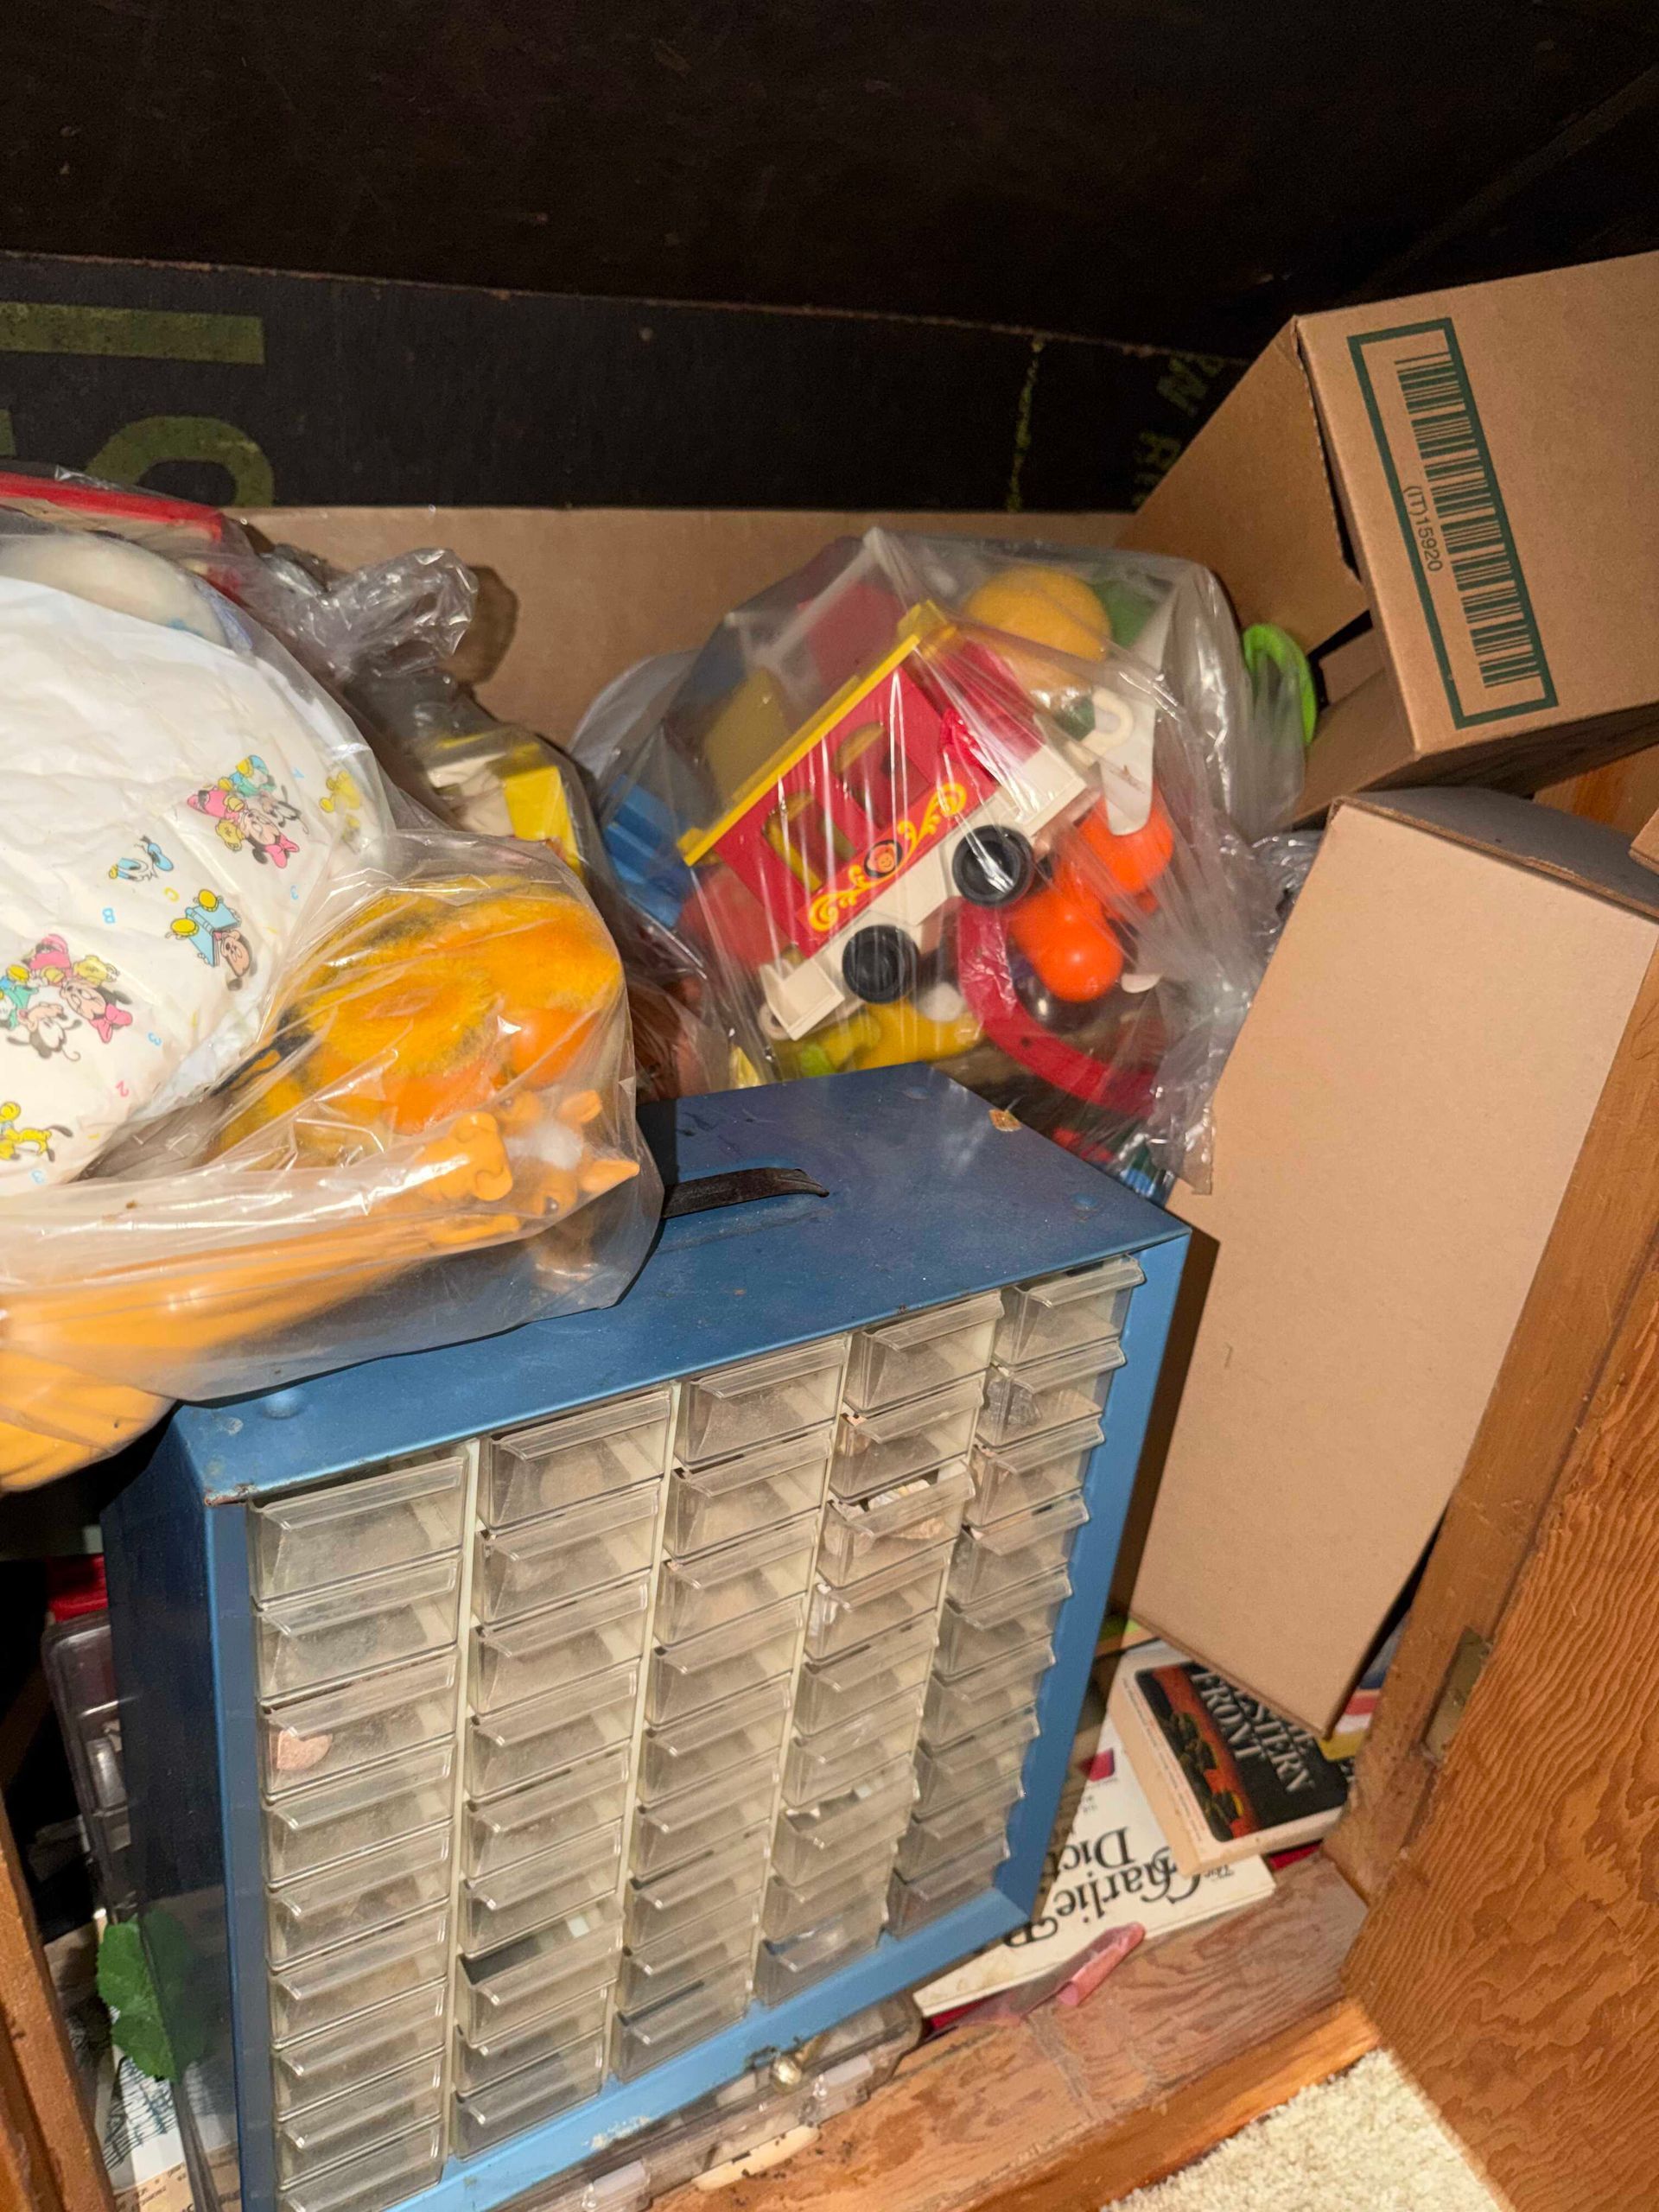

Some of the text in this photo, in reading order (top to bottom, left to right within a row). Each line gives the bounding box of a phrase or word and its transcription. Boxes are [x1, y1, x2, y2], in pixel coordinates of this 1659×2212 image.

[1402, 486, 1444, 572] (IT)15920
[101, 907, 116, 925] B
[147, 1031, 162, 1046] 3
[115, 1080, 129, 1097] 2
[1191, 1670, 1268, 1761] FRONT
[1052, 1846, 1201, 1923] Charlie
